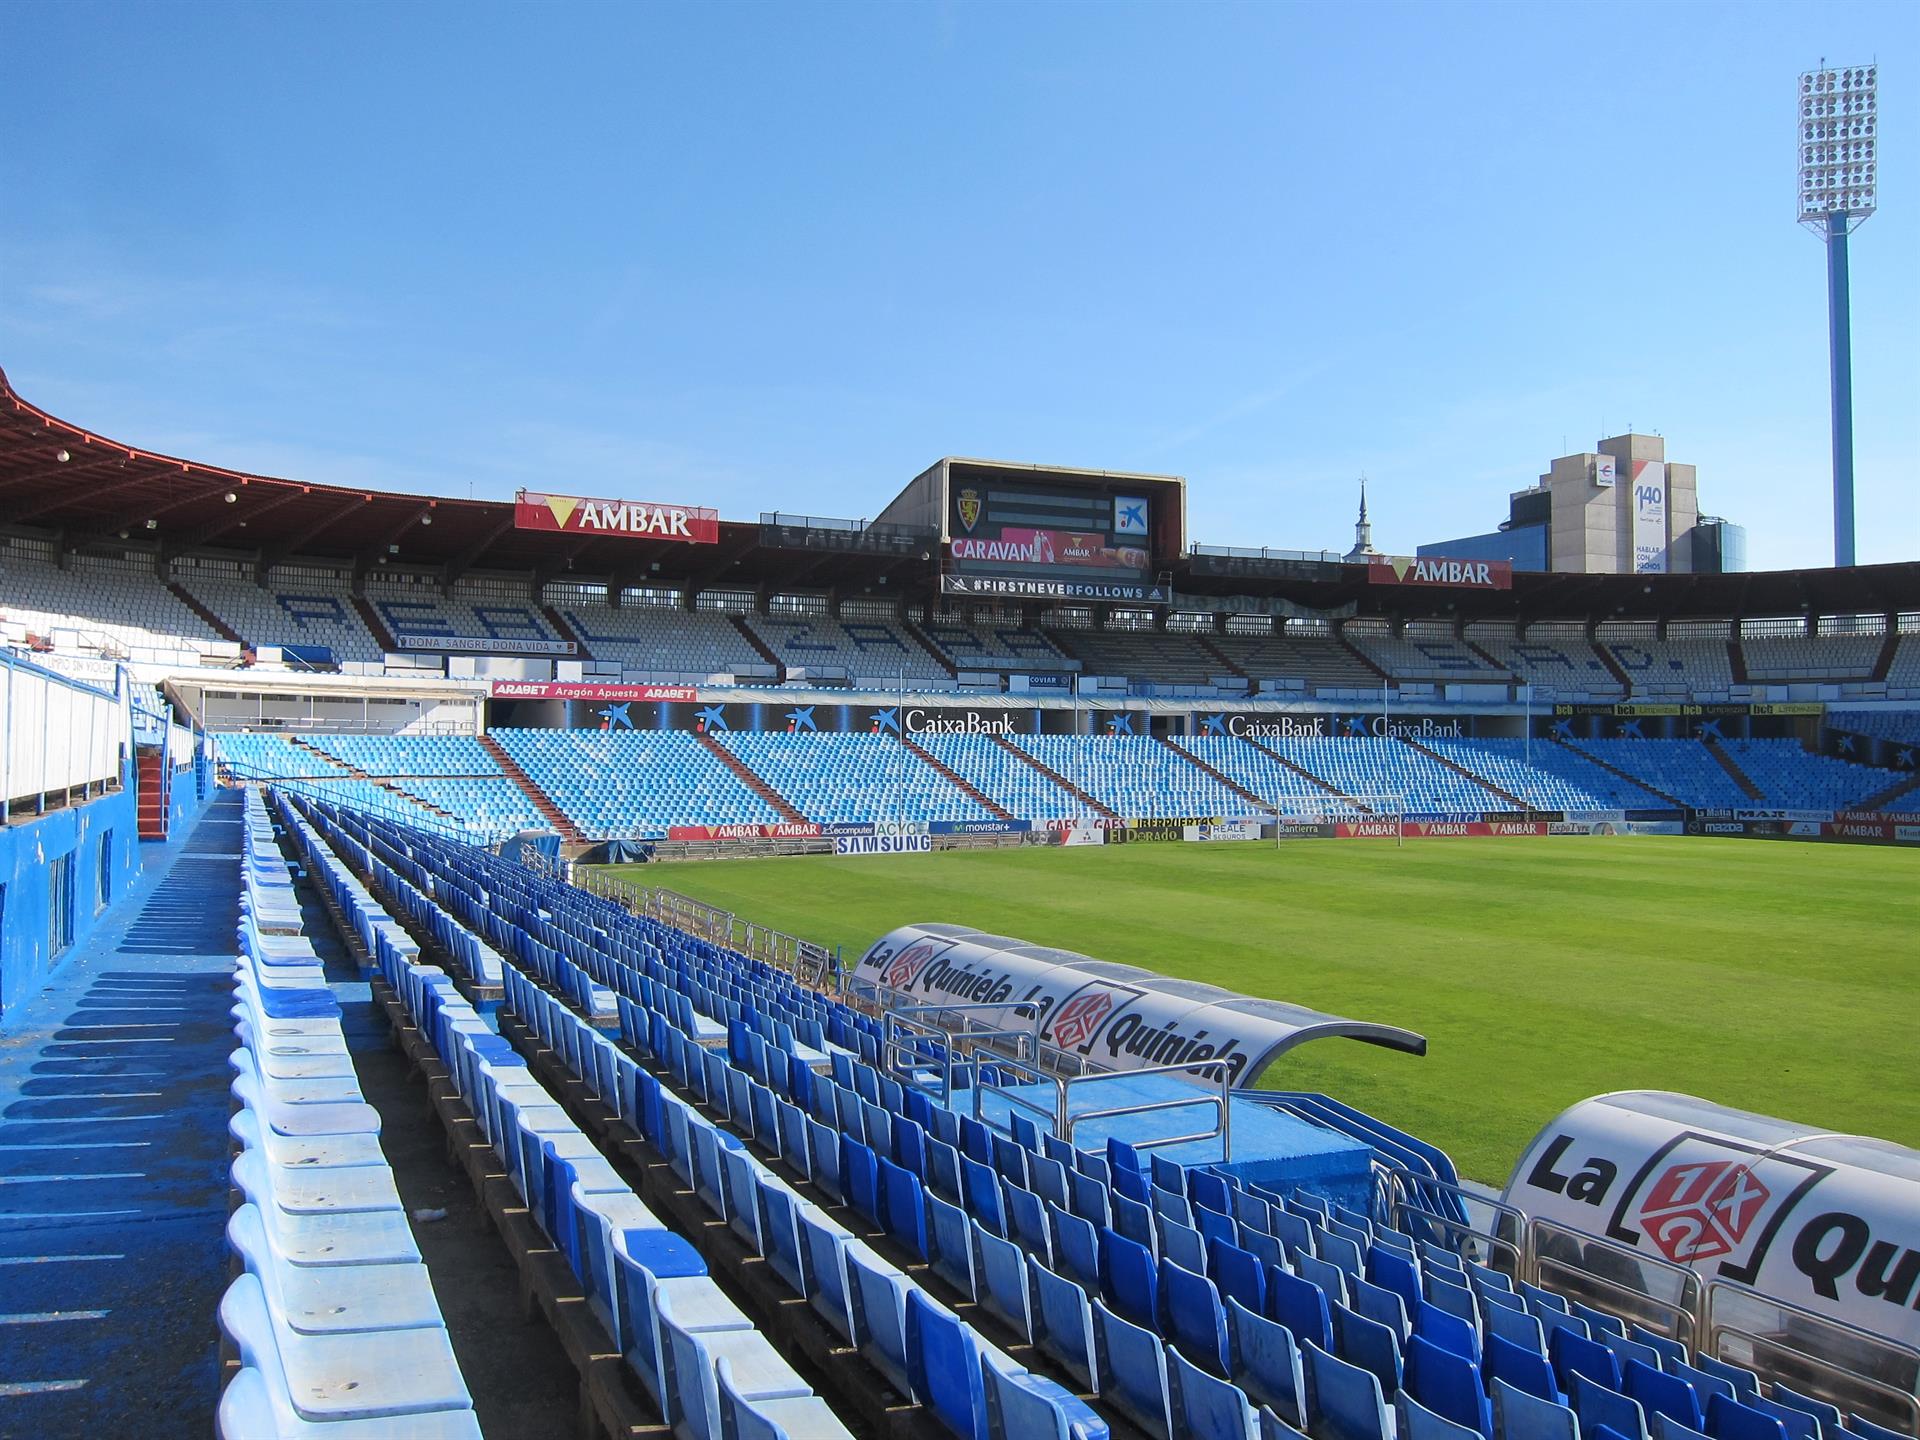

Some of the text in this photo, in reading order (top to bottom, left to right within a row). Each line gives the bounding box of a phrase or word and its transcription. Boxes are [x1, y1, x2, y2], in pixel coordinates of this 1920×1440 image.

[579, 502, 692, 537] AMBAR
[951, 539, 1034, 562] CARAVAN
[1063, 547, 1090, 557] AMBAR
[1413, 560, 1493, 585] AMBAR
[973, 579, 1143, 599] #FIRSTNEVERFOLLOWS
[409, 637, 549, 651] DONA SANGRE, DONA VIDA
[1029, 676, 1057, 684] COVIAR
[495, 684, 695, 699] ARABET Aragón Apuesta ARABET
[906, 710, 1016, 734] CaixaBank
[1229, 716, 1324, 737] CaixaBank
[1372, 717, 1463, 738] CaixaBank
[1447, 813, 1482, 823] TILCA
[1846, 811, 1878, 821] AMBAR
[965, 823, 1010, 832] movistar+
[1046, 819, 1077, 831] GAES
[1094, 818, 1126, 829] GAES
[1213, 824, 1246, 833] REALE
[1429, 824, 1468, 835] AMBAR
[1500, 823, 1537, 834] AMBAR
[1705, 823, 1744, 833] mazda
[718, 825, 760, 838] AMBAR
[777, 824, 818, 836] AMBAR
[833, 826, 873, 836] ecomputer
[1358, 824, 1397, 836] AMBAR
[1842, 825, 1884, 837] AMBAR
[838, 835, 931, 854] SAMSUNG
[864, 941, 893, 970] La
[923, 959, 1013, 1003] Quiniela
[1014, 985, 1055, 1020] La
[1106, 1013, 1248, 1086] Quiniela
[1527, 1134, 1618, 1206] La
[1792, 1211, 1920, 1311] Qu
